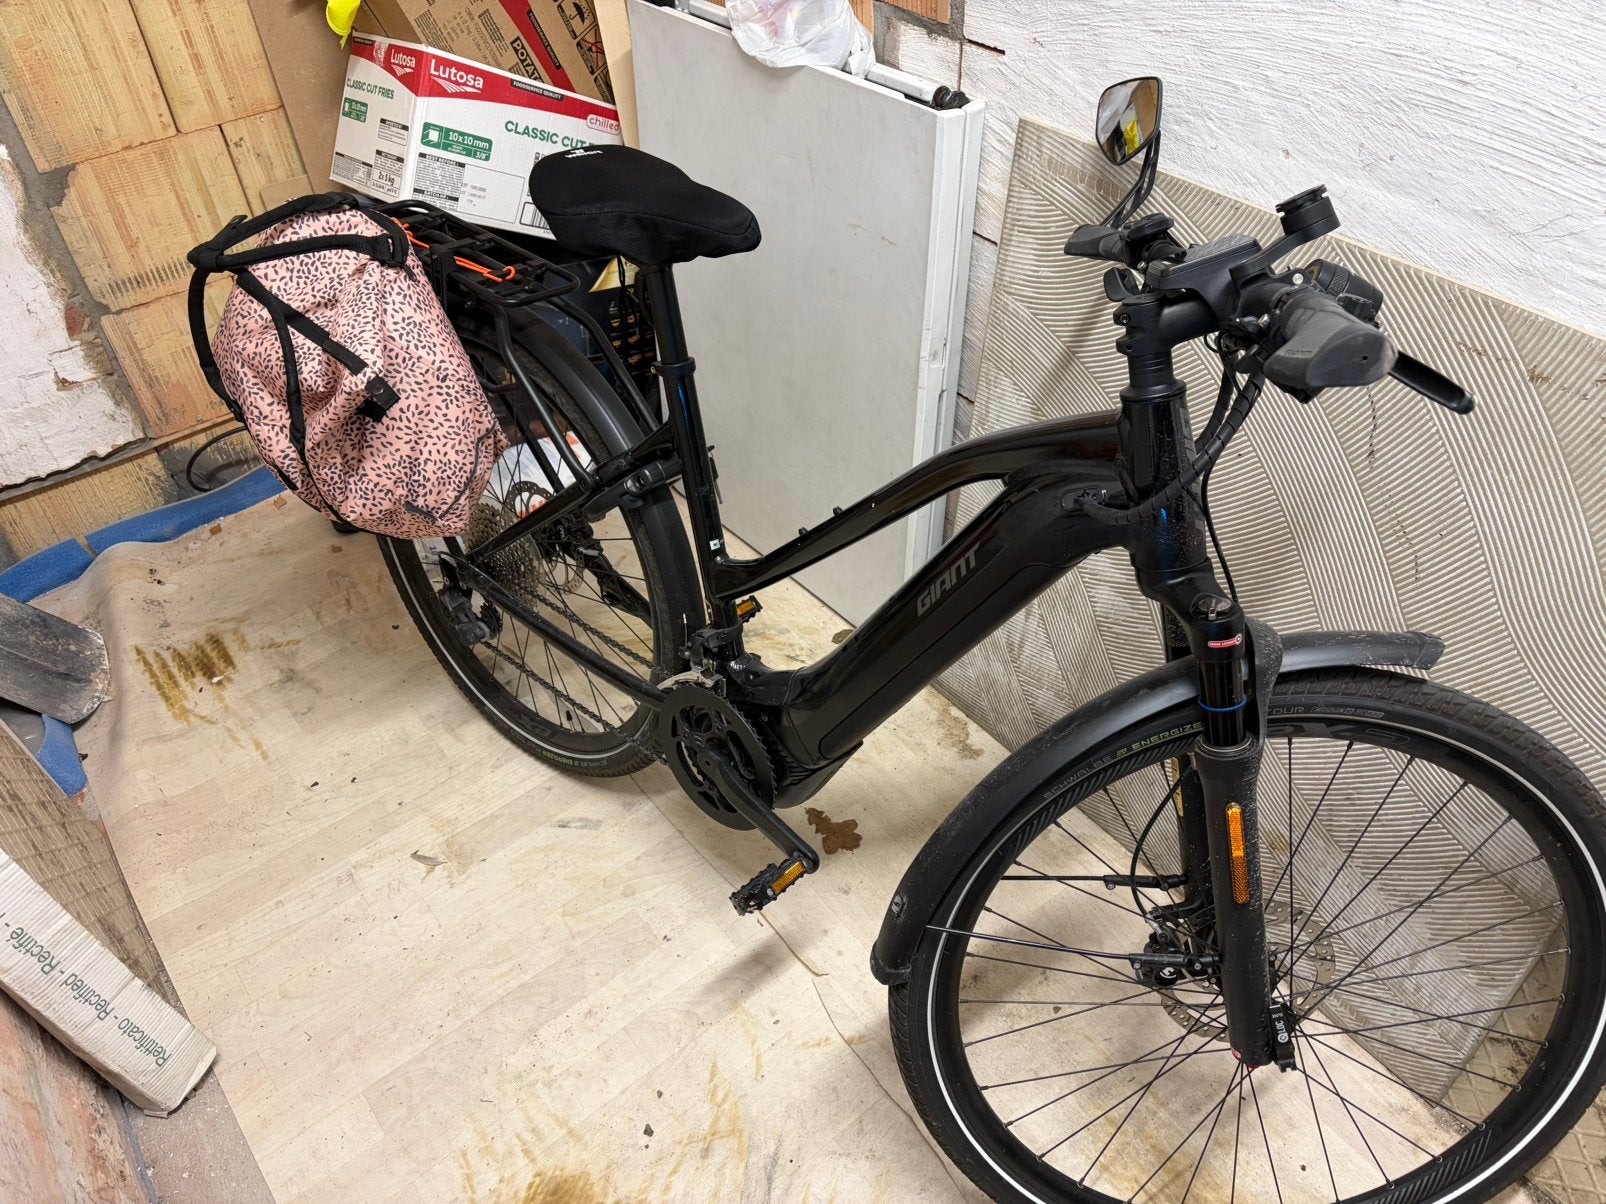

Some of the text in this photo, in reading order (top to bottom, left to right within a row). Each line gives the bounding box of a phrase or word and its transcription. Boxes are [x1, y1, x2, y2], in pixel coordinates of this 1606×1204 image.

[528, 12, 560, 66] FOODSERVICE QUALITY
[390, 49, 416, 68] Lutosa
[430, 58, 484, 88] Lutosa
[346, 78, 394, 99] CLASSIC CUT FRIES
[513, 80, 562, 99] FOODSERVICE QUALITY
[505, 120, 586, 148] CLASSIC CUT
[589, 116, 620, 131] chilled
[916, 542, 980, 616] GIANT
[1043, 756, 1112, 799] SCHWALBE
[6, 926, 61, 976] Rectifié
[60, 972, 114, 1022] Rectified
[118, 1017, 172, 1068] Rettificato
